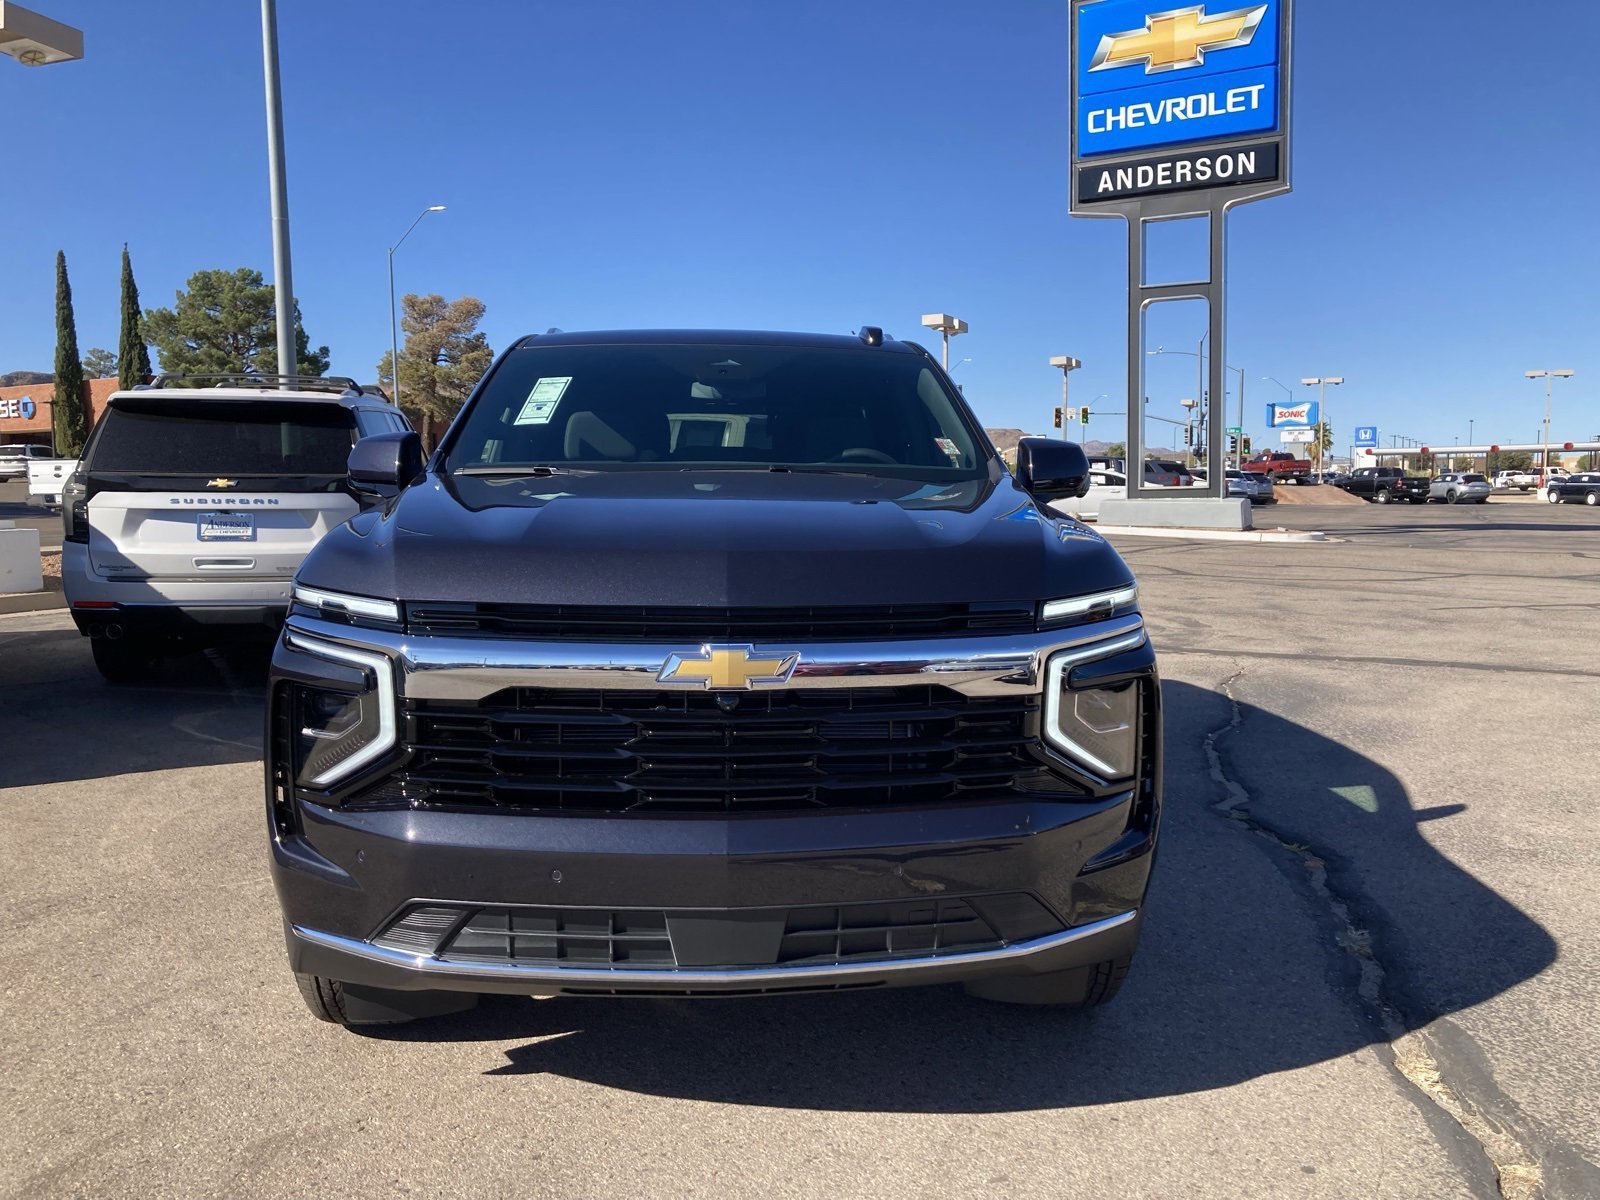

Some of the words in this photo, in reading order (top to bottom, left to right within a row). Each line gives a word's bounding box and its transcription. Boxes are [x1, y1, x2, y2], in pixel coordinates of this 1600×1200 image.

[1087, 84, 1265, 134] CHEVROLET
[1097, 151, 1255, 193] ANDERSON
[1277, 410, 1305, 419] SONIC
[203, 519, 250, 531] ANDERSON
